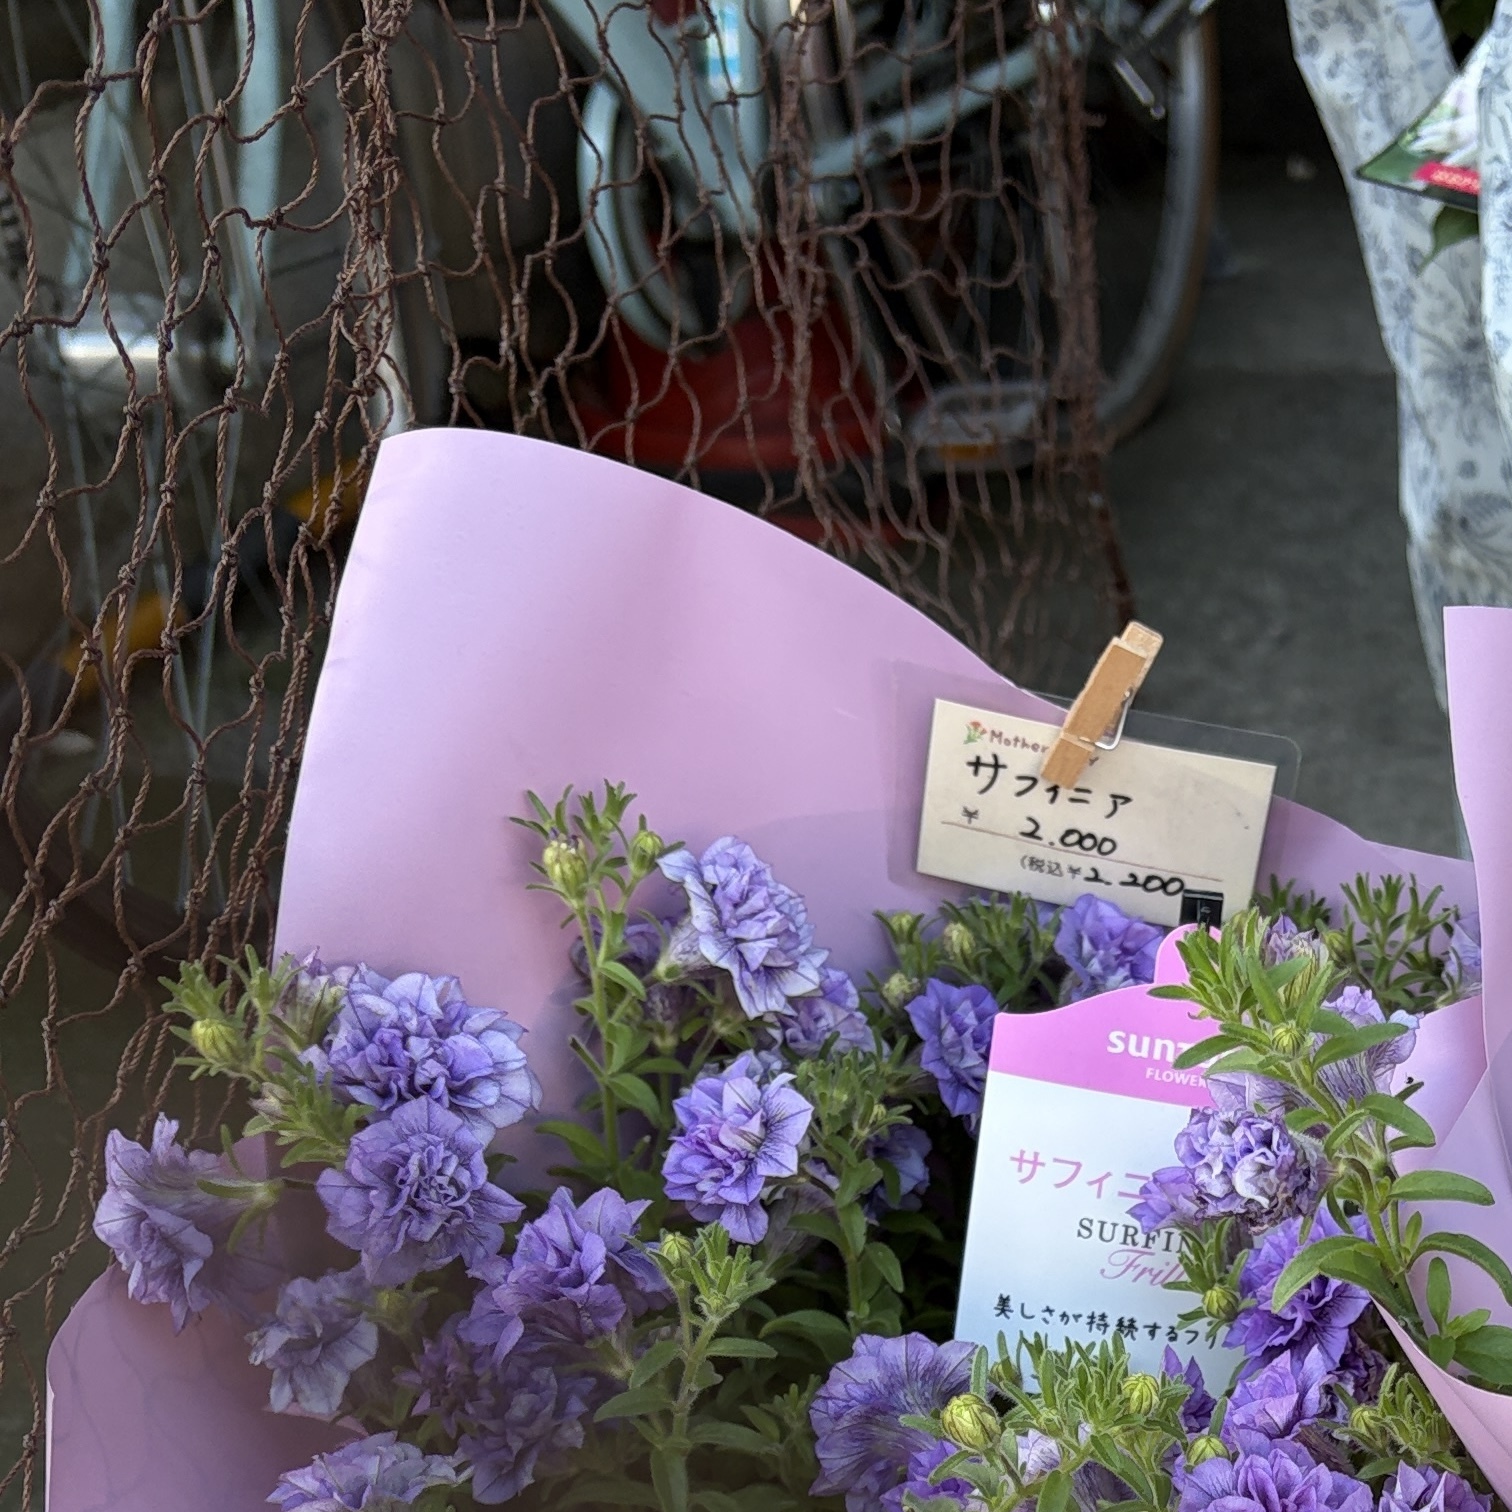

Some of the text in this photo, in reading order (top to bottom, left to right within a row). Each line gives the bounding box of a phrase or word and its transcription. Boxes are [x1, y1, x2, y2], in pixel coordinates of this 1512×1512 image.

[988, 728, 1051, 754] Mother
[966, 753, 1134, 819] サフィニア
[1009, 1148, 1151, 1200] サフィニ
